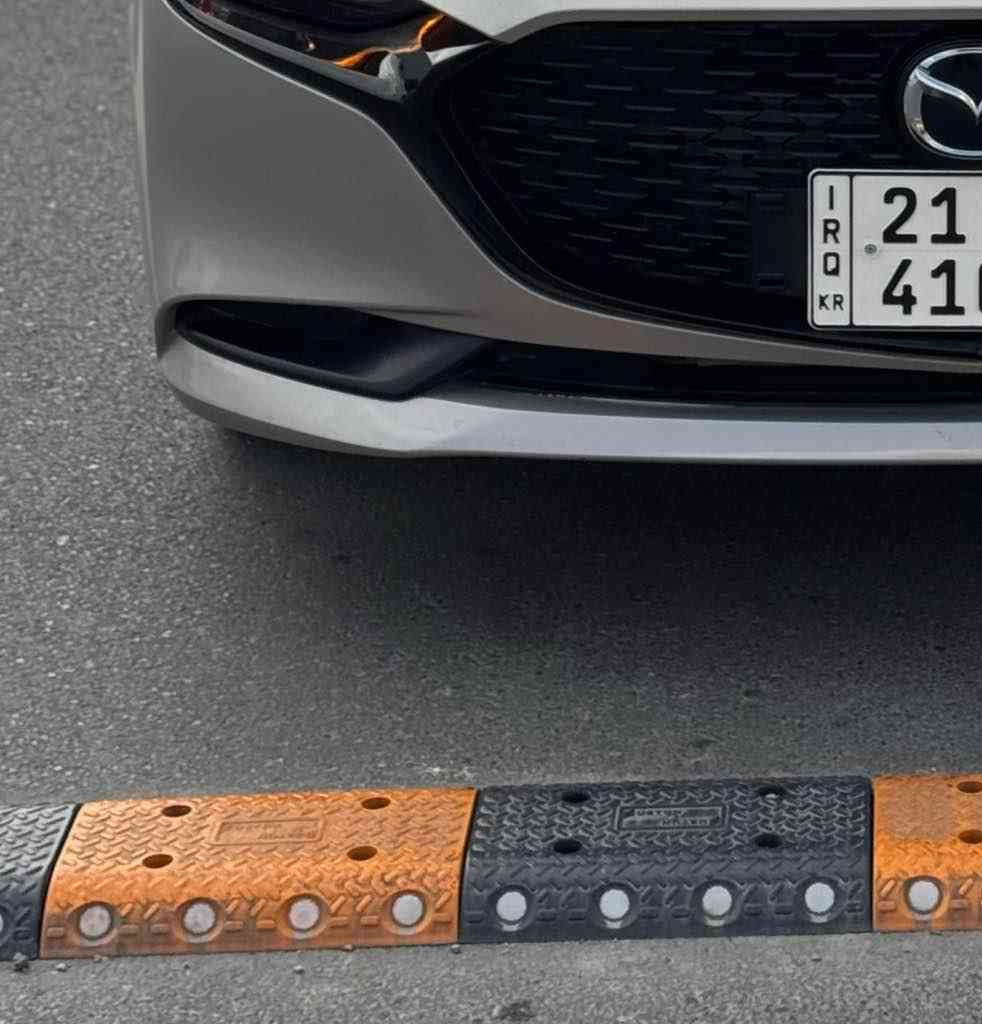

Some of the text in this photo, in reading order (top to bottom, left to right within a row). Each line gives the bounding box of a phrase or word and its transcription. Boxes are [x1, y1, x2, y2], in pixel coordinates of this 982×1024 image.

[822, 185, 841, 277] IRQ
[882, 186, 966, 245] 21
[818, 293, 845, 311] KR
